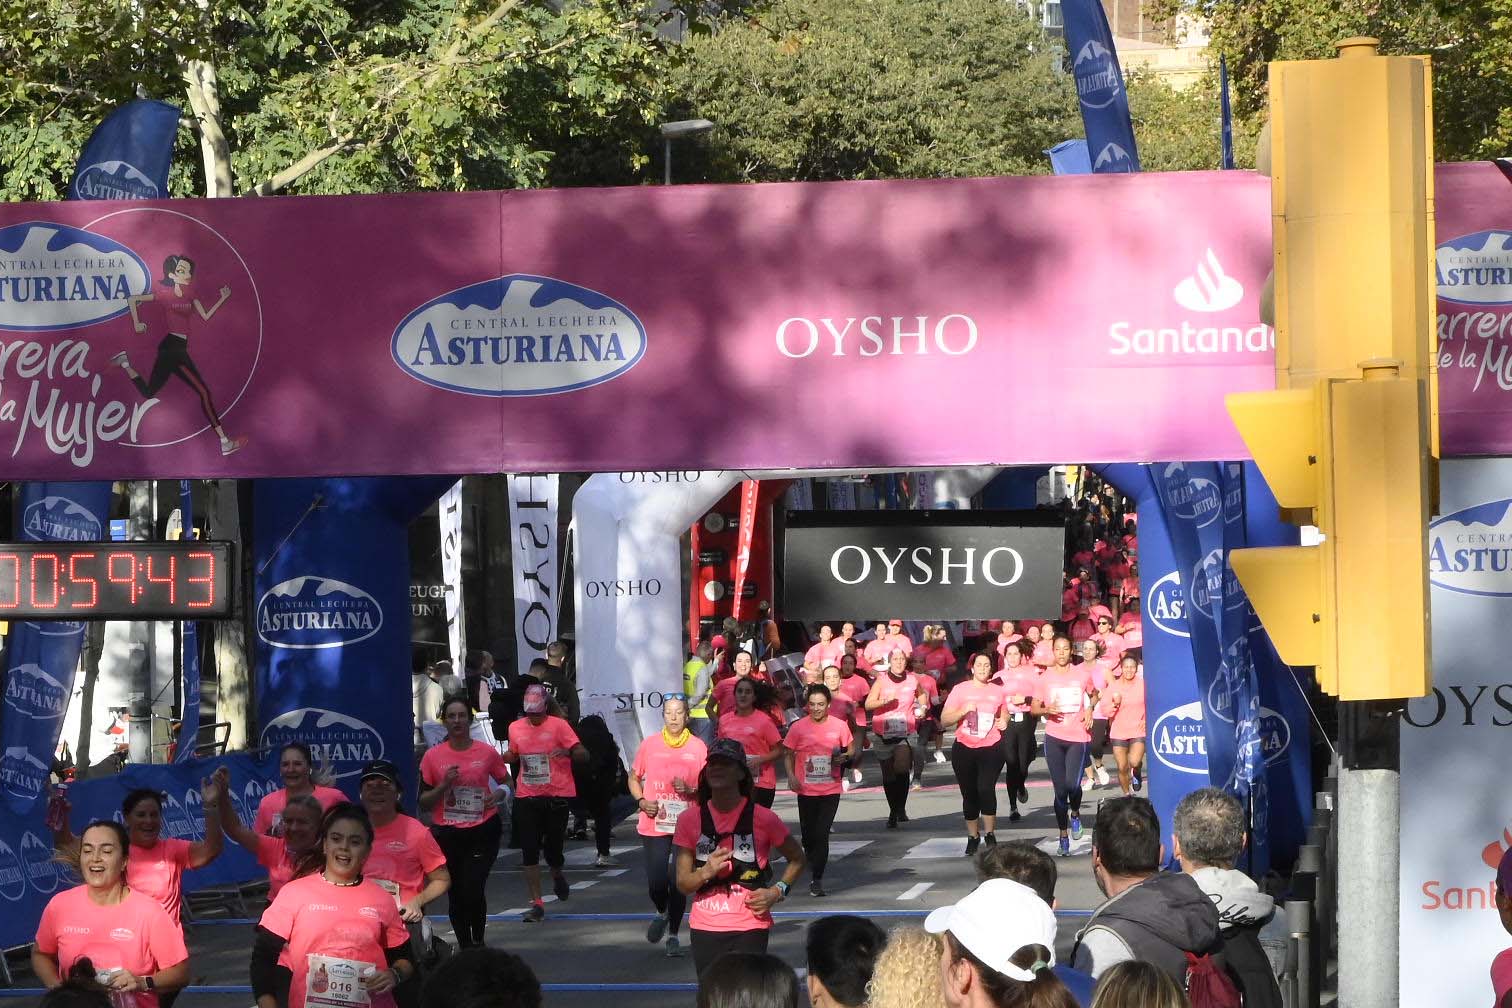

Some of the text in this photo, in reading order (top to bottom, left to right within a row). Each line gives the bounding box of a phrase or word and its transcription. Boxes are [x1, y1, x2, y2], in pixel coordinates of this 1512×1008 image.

[54, 258, 126, 269] LECHERA
[1450, 255, 1501, 264] CENTRAL
[450, 315, 618, 330] CENTRAL LECHERA
[411, 322, 626, 367] ASTURIANA
[775, 314, 979, 358] OYSHO
[1459, 340, 1477, 368] la
[12, 374, 160, 468] Mujer
[830, 545, 1024, 587] OYSHO
[585, 578, 662, 599] OYSHO
[321, 600, 368, 608] LECHERA
[261, 606, 373, 632] ASTURIANA
[321, 731, 368, 739] LECHERA
[330, 981, 352, 992] 016
